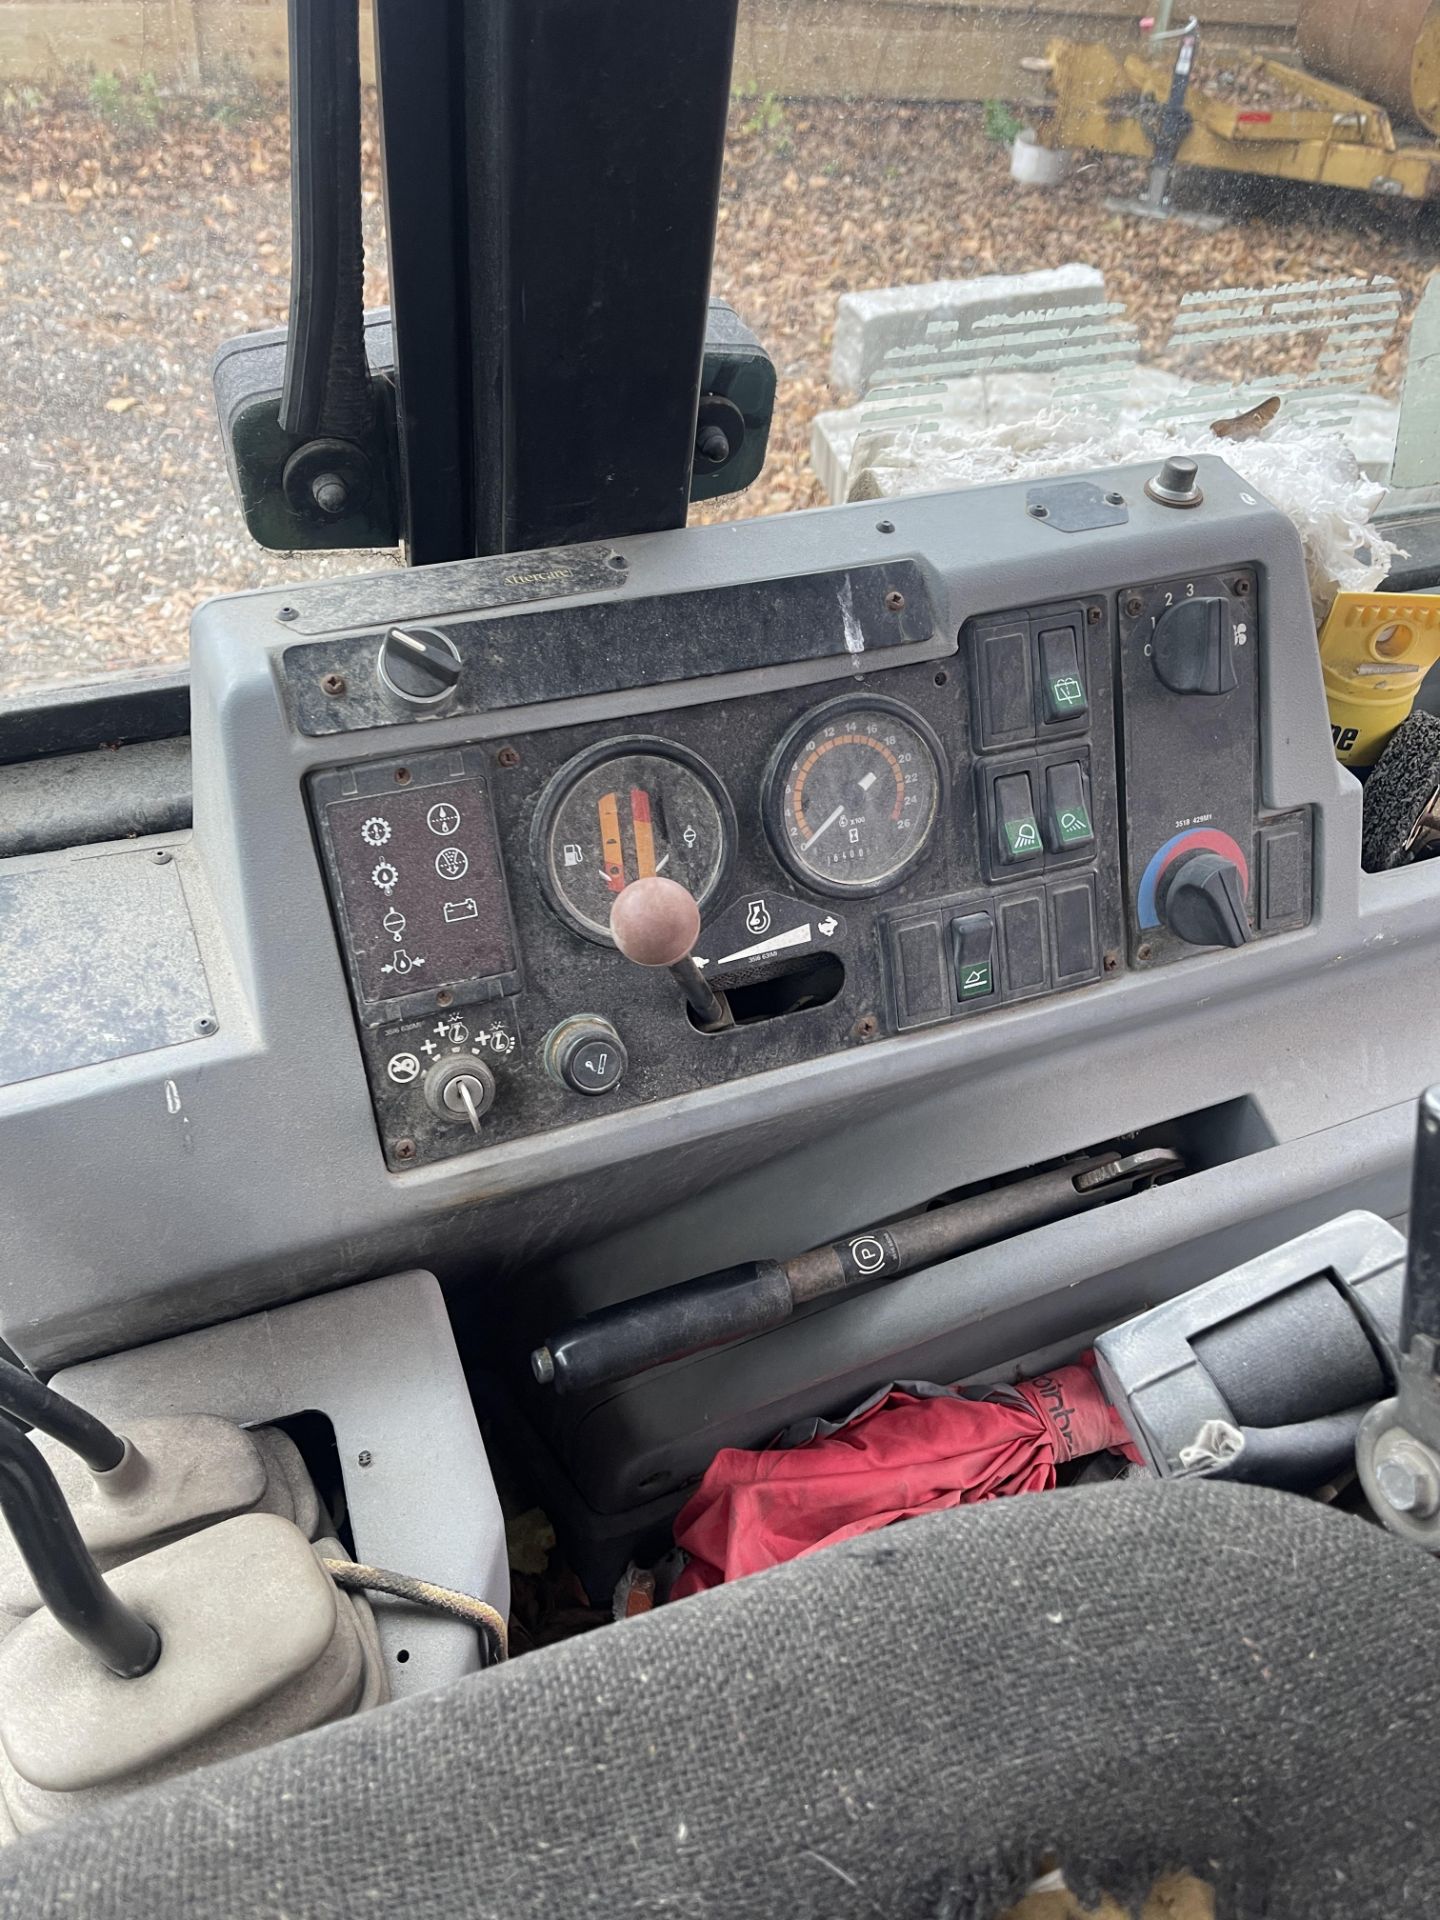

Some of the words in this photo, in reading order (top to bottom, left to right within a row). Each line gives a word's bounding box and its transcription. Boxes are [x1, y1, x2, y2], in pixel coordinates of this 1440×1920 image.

[1186, 583, 1194, 597] 3
[1164, 592, 1173, 607] 2
[1150, 616, 1156, 629] 1
[823, 727, 835, 738] 12
[845, 722, 857, 733] 14
[866, 724, 878, 735] 16
[805, 740, 816, 751] 10
[883, 735, 896, 746] 18
[898, 752, 911, 764] 20
[904, 773, 918, 784] 22
[904, 795, 917, 806] 24
[897, 818, 911, 830] 26
[790, 826, 798, 836] 2
